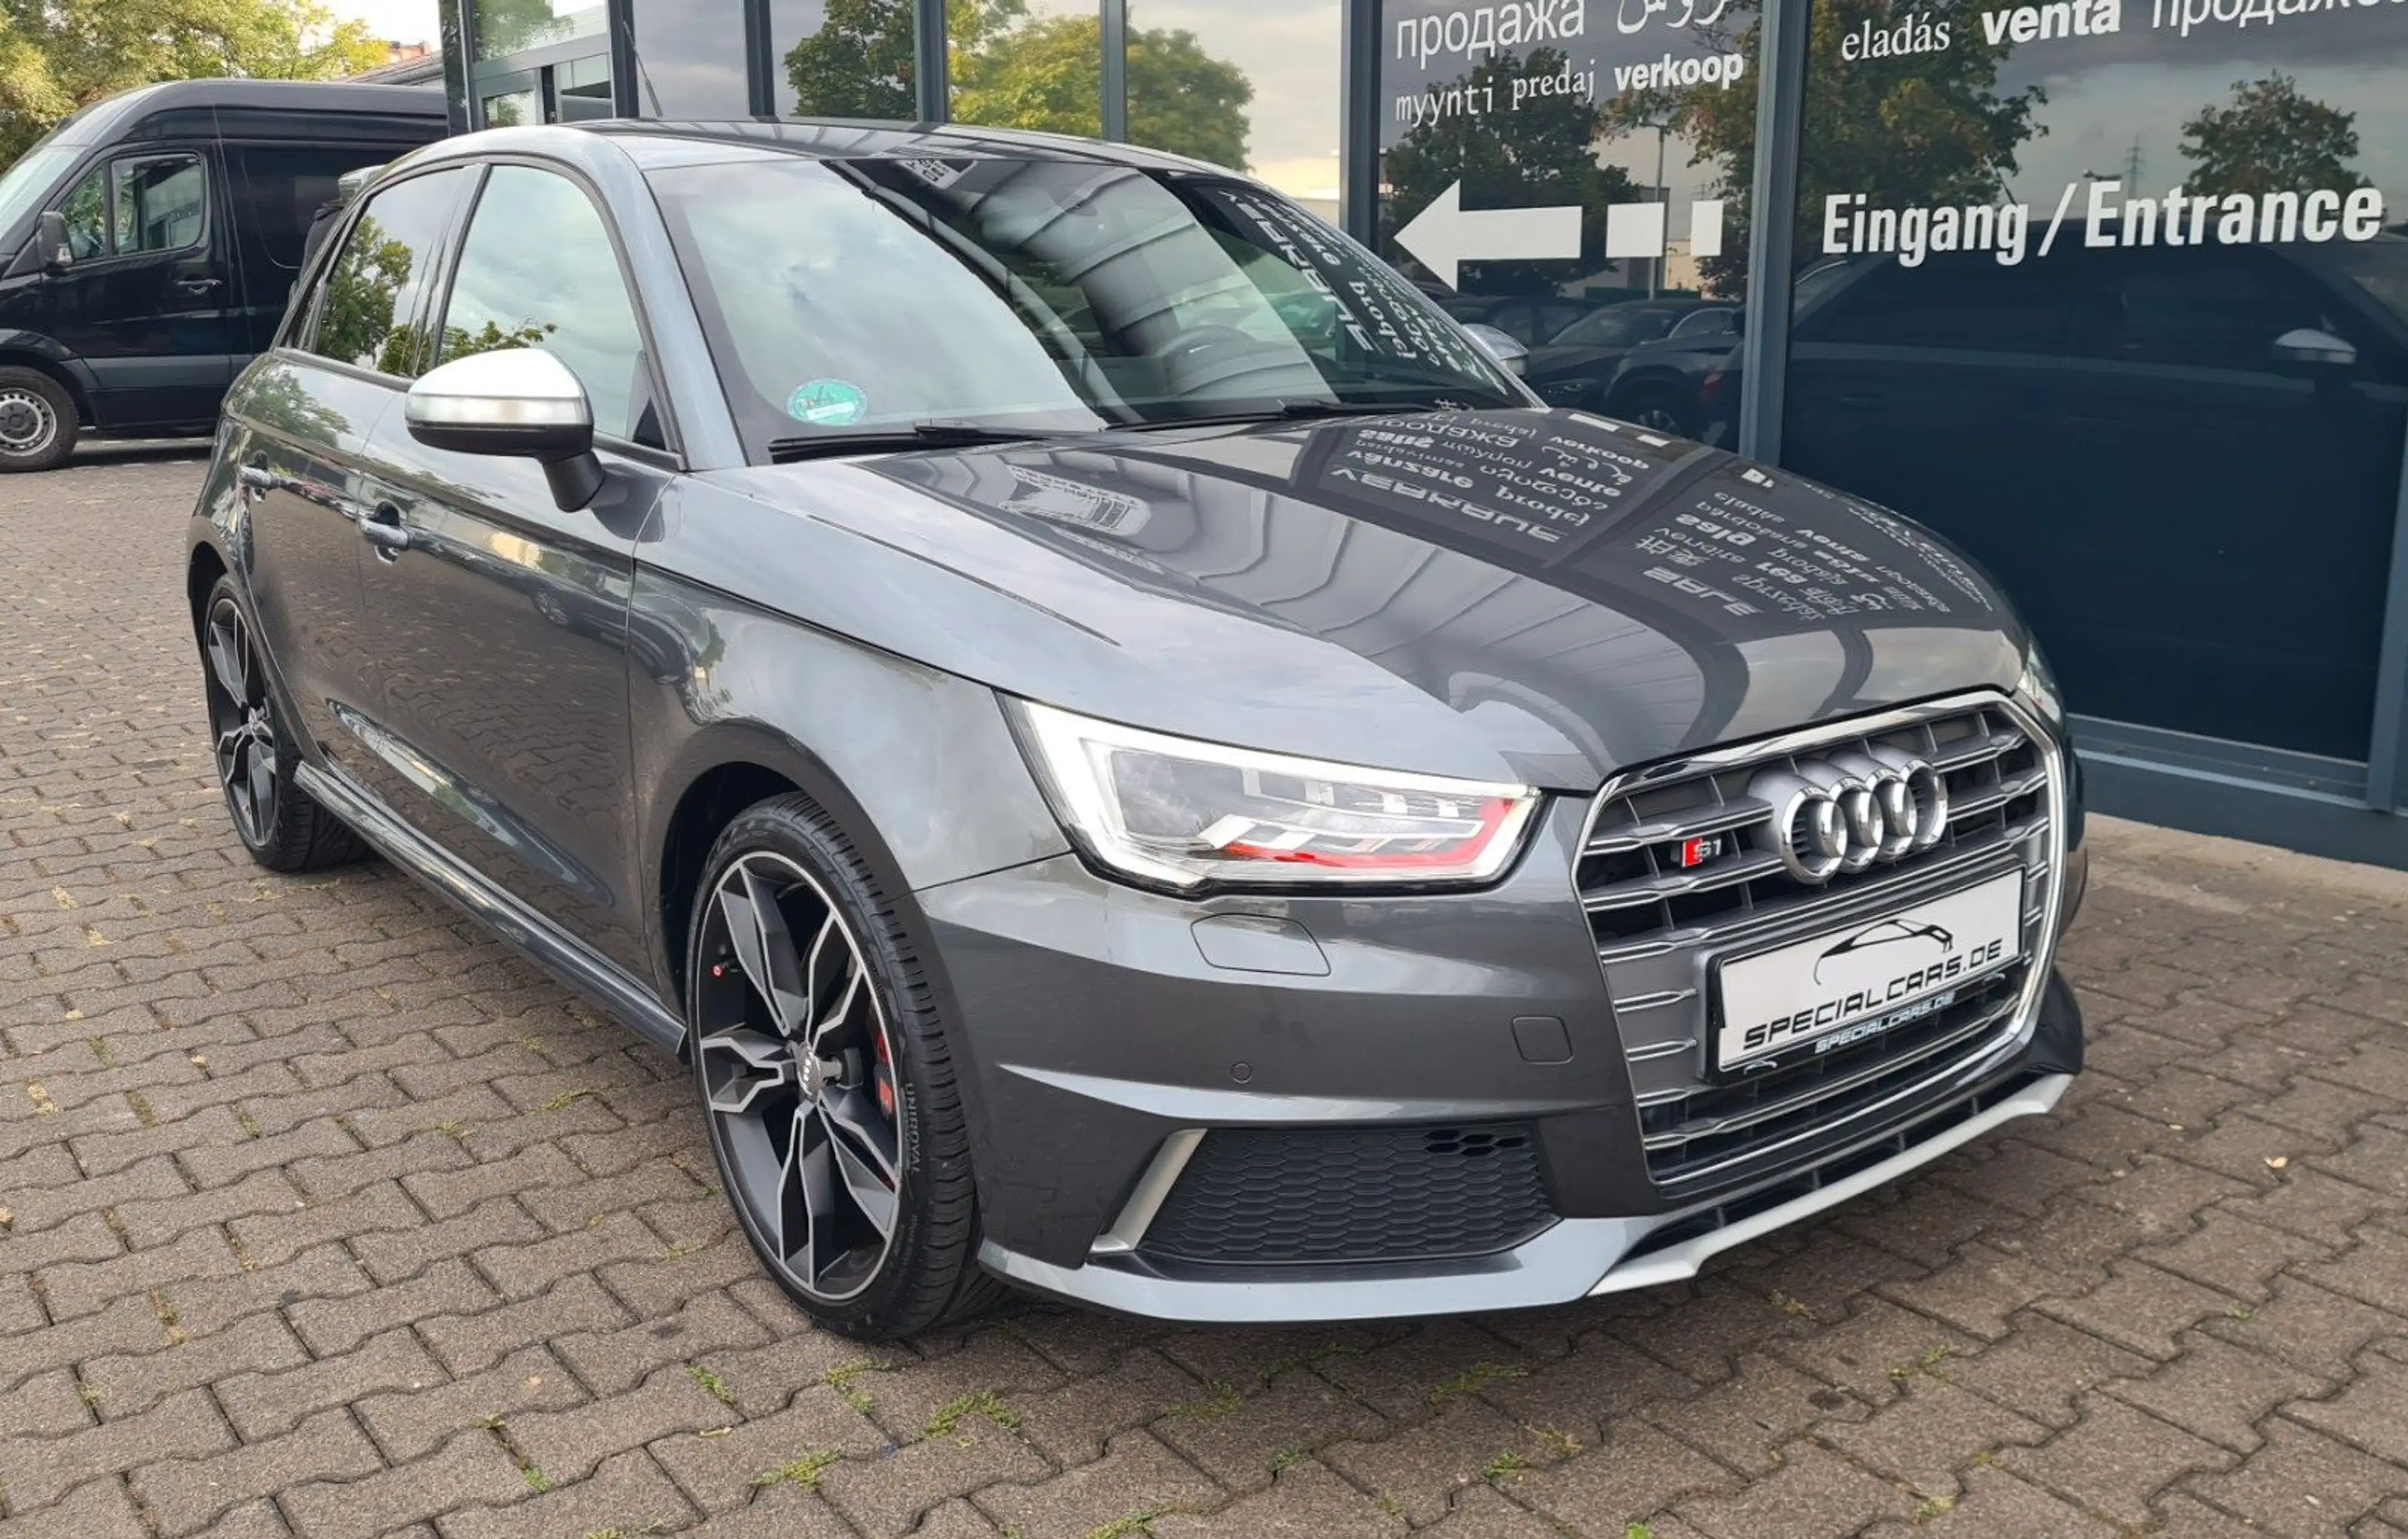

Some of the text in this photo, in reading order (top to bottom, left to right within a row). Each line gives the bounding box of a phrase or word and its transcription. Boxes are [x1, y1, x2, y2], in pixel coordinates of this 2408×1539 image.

[1397, 0, 1585, 70] продажа
[1840, 0, 2121, 61] eladás venta
[1395, 53, 1744, 128] myynti predaj verkoop
[1822, 194, 2029, 268] Eingang
[2084, 180, 2384, 247] Entrance
[1743, 938, 2003, 1051] SPECIALCARS.DE
